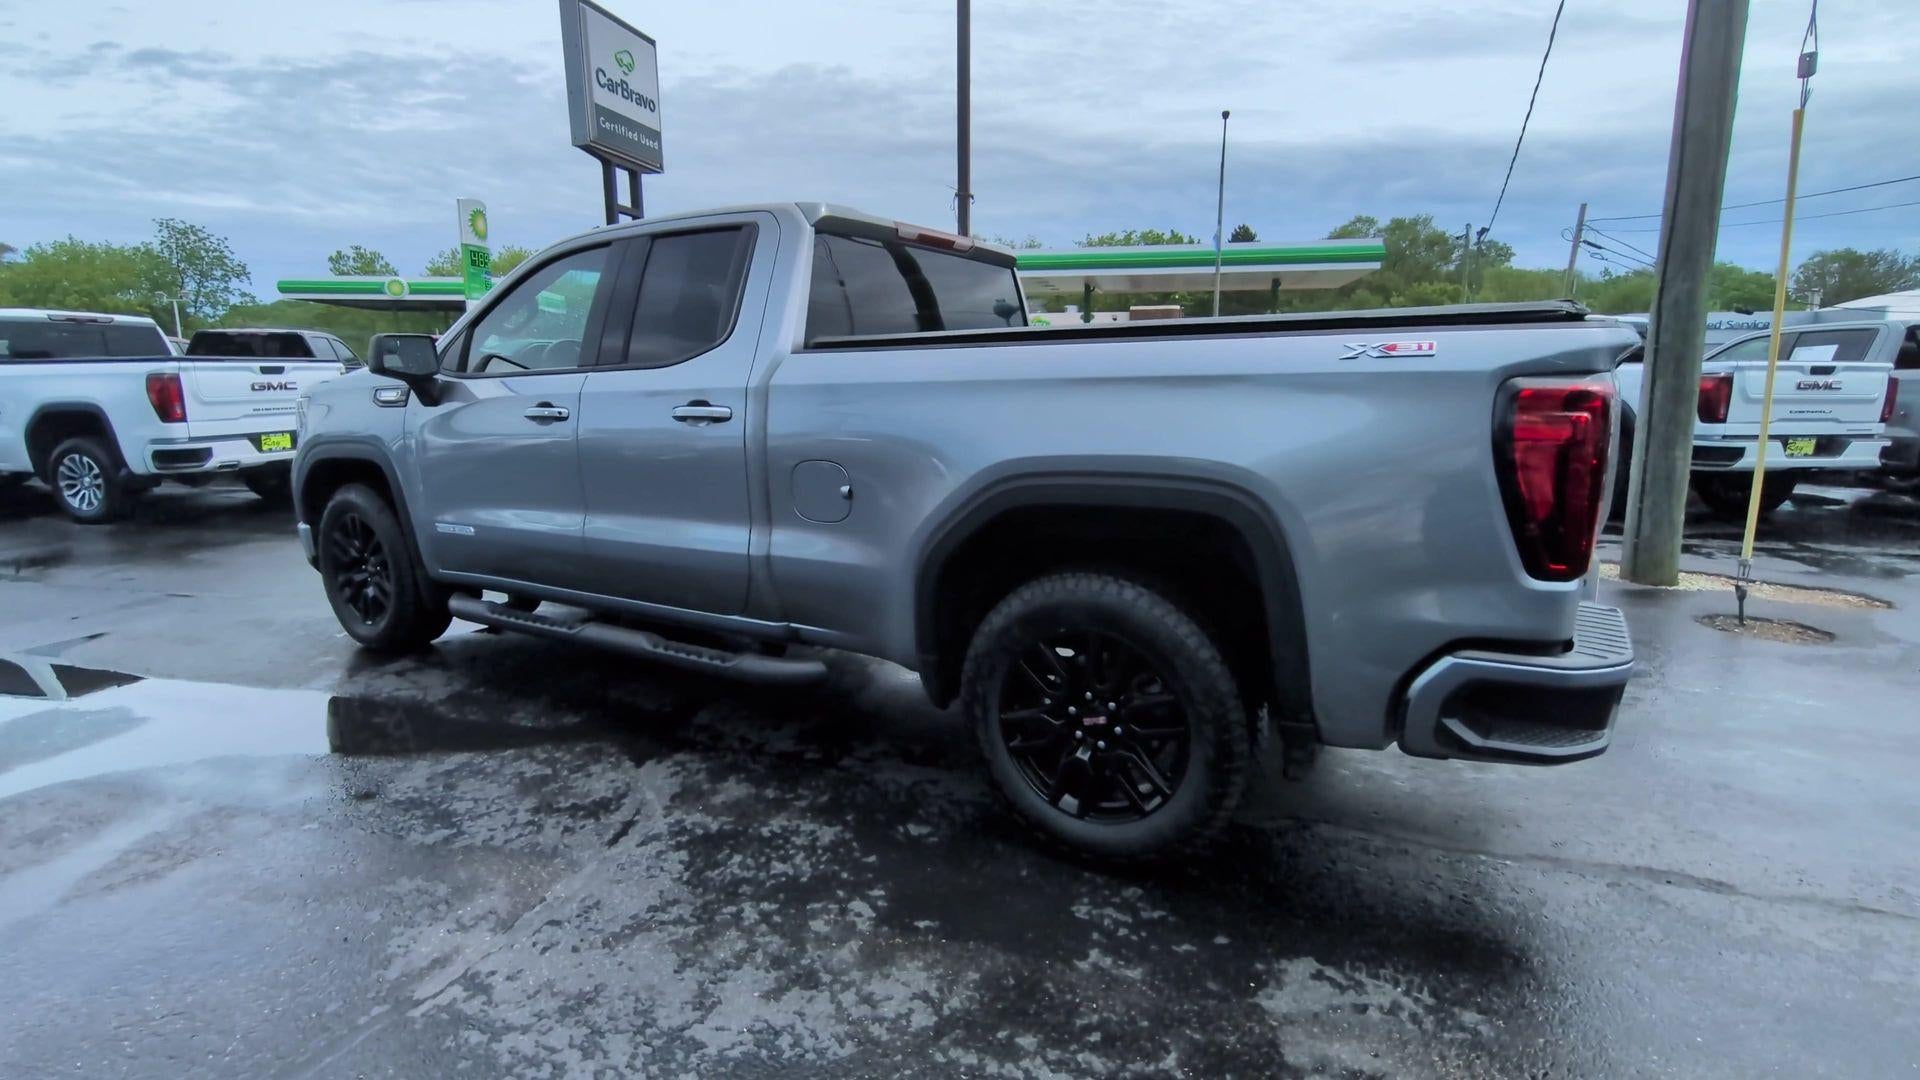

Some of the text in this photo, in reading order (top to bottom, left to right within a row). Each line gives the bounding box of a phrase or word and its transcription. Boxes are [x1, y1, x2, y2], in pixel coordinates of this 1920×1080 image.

[595, 67, 656, 113] CarBravo
[599, 117, 659, 150] Certified Used
[1726, 320, 1771, 330] Service
[250, 382, 298, 391] GMC
[1797, 381, 1842, 391] GMC
